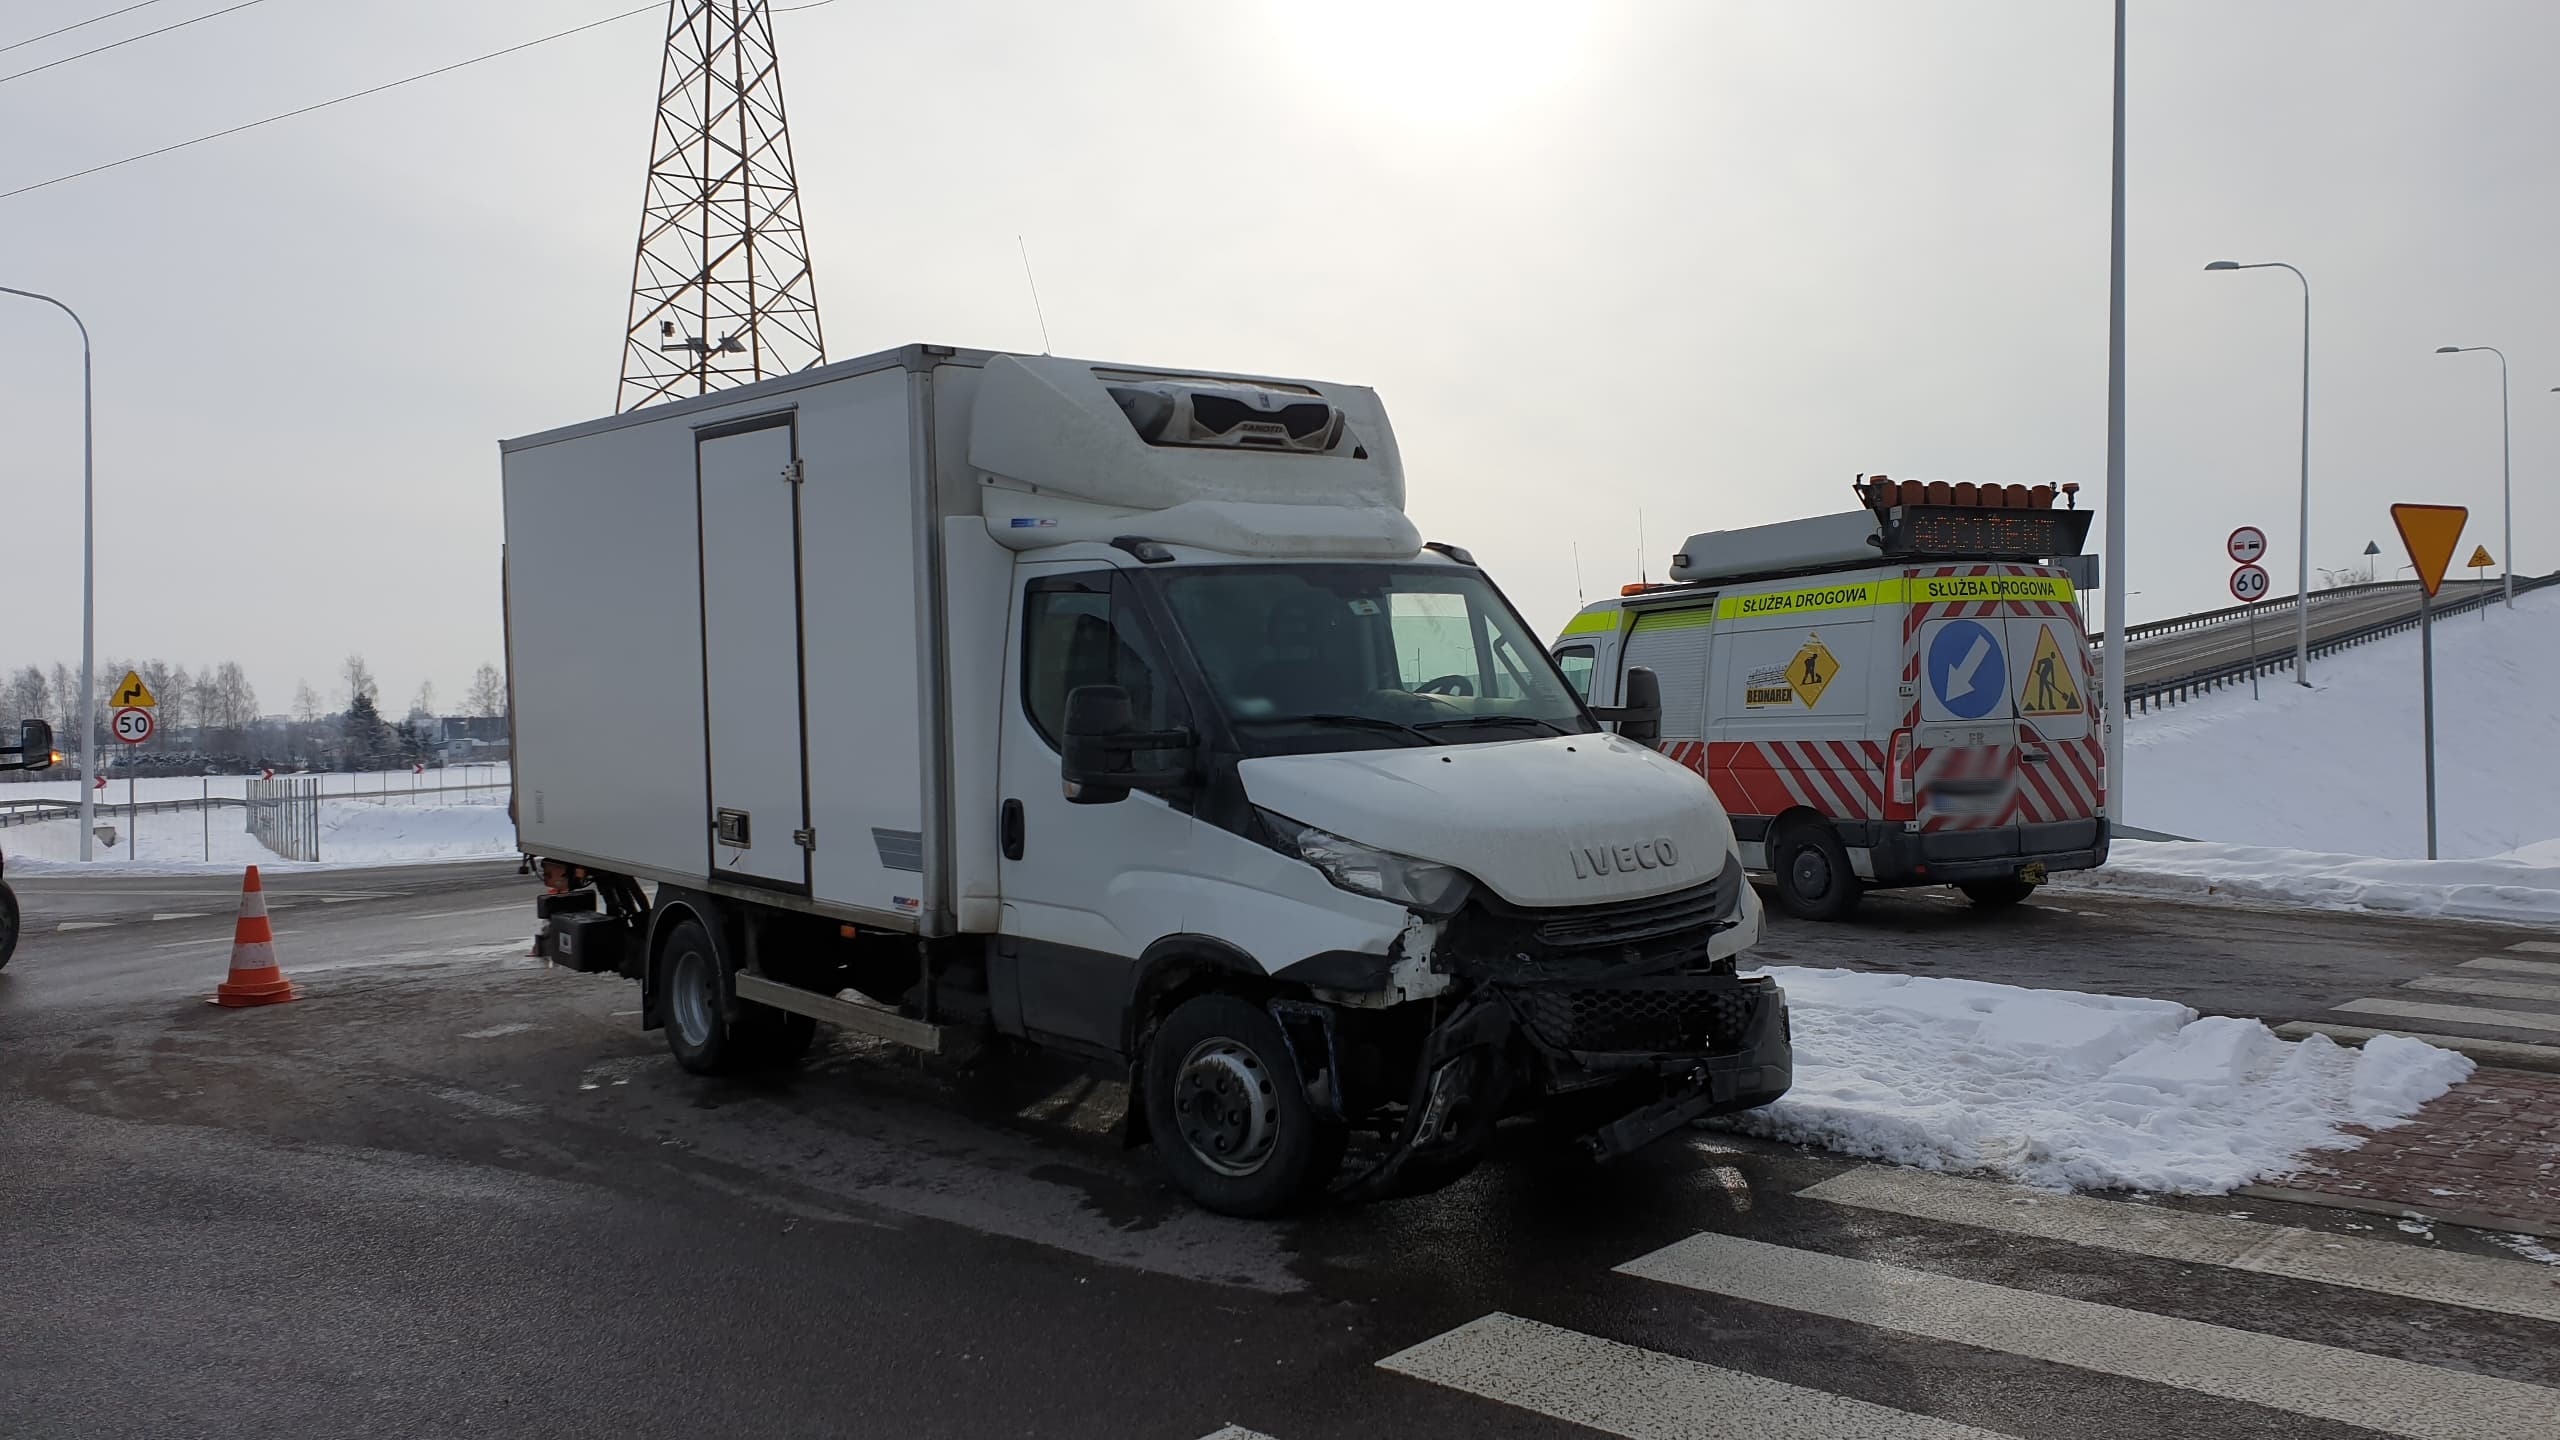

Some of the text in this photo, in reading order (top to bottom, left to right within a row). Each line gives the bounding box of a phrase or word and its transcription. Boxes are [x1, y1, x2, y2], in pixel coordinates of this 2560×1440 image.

[1915, 516, 2057, 550] ACCIDENT
[1928, 578, 2056, 597] SŁUŻBA DROGOWA
[2236, 573, 2264, 592] 60
[1743, 587, 1868, 613] SŁUŻBA DROGOWA
[119, 716, 148, 734] 50
[1568, 839, 1680, 879] IVECO
